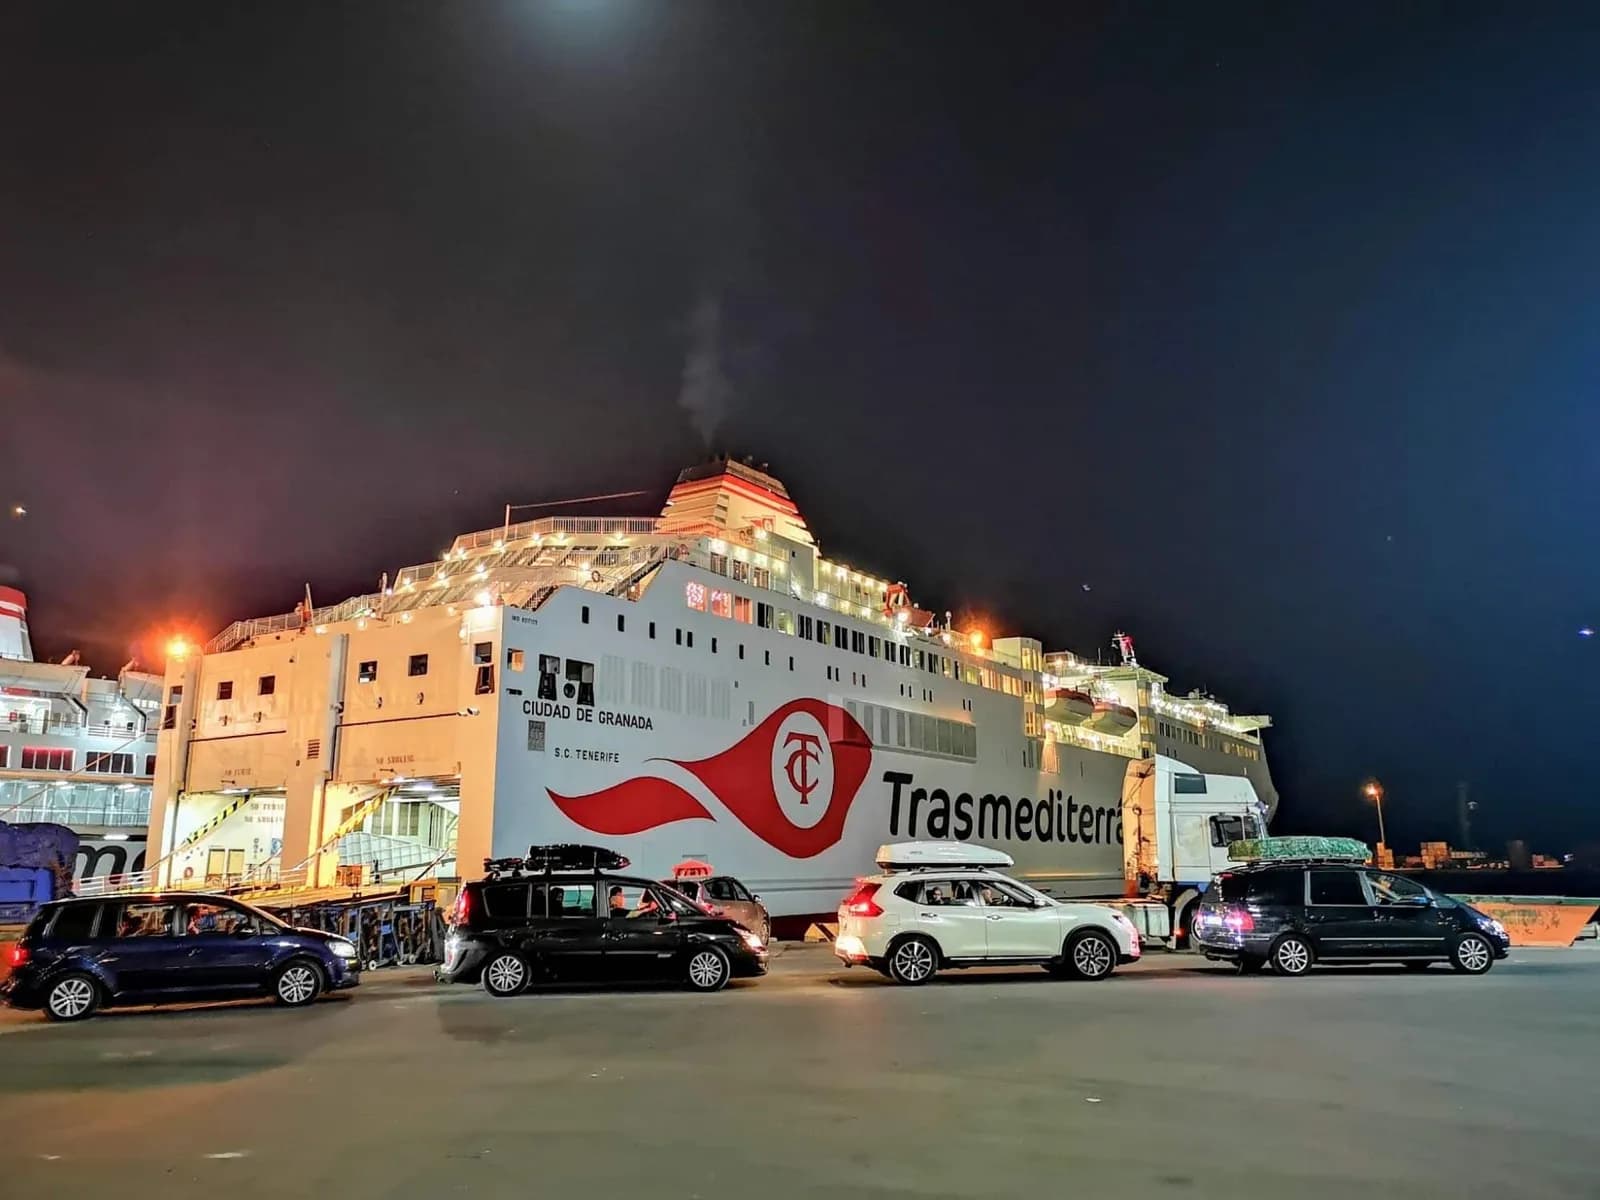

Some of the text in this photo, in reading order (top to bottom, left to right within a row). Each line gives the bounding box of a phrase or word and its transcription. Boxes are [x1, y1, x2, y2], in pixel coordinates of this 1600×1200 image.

[523, 700, 653, 731] CIUDAD DE GRANADA
[555, 747, 620, 763] S.C. TENERIFE
